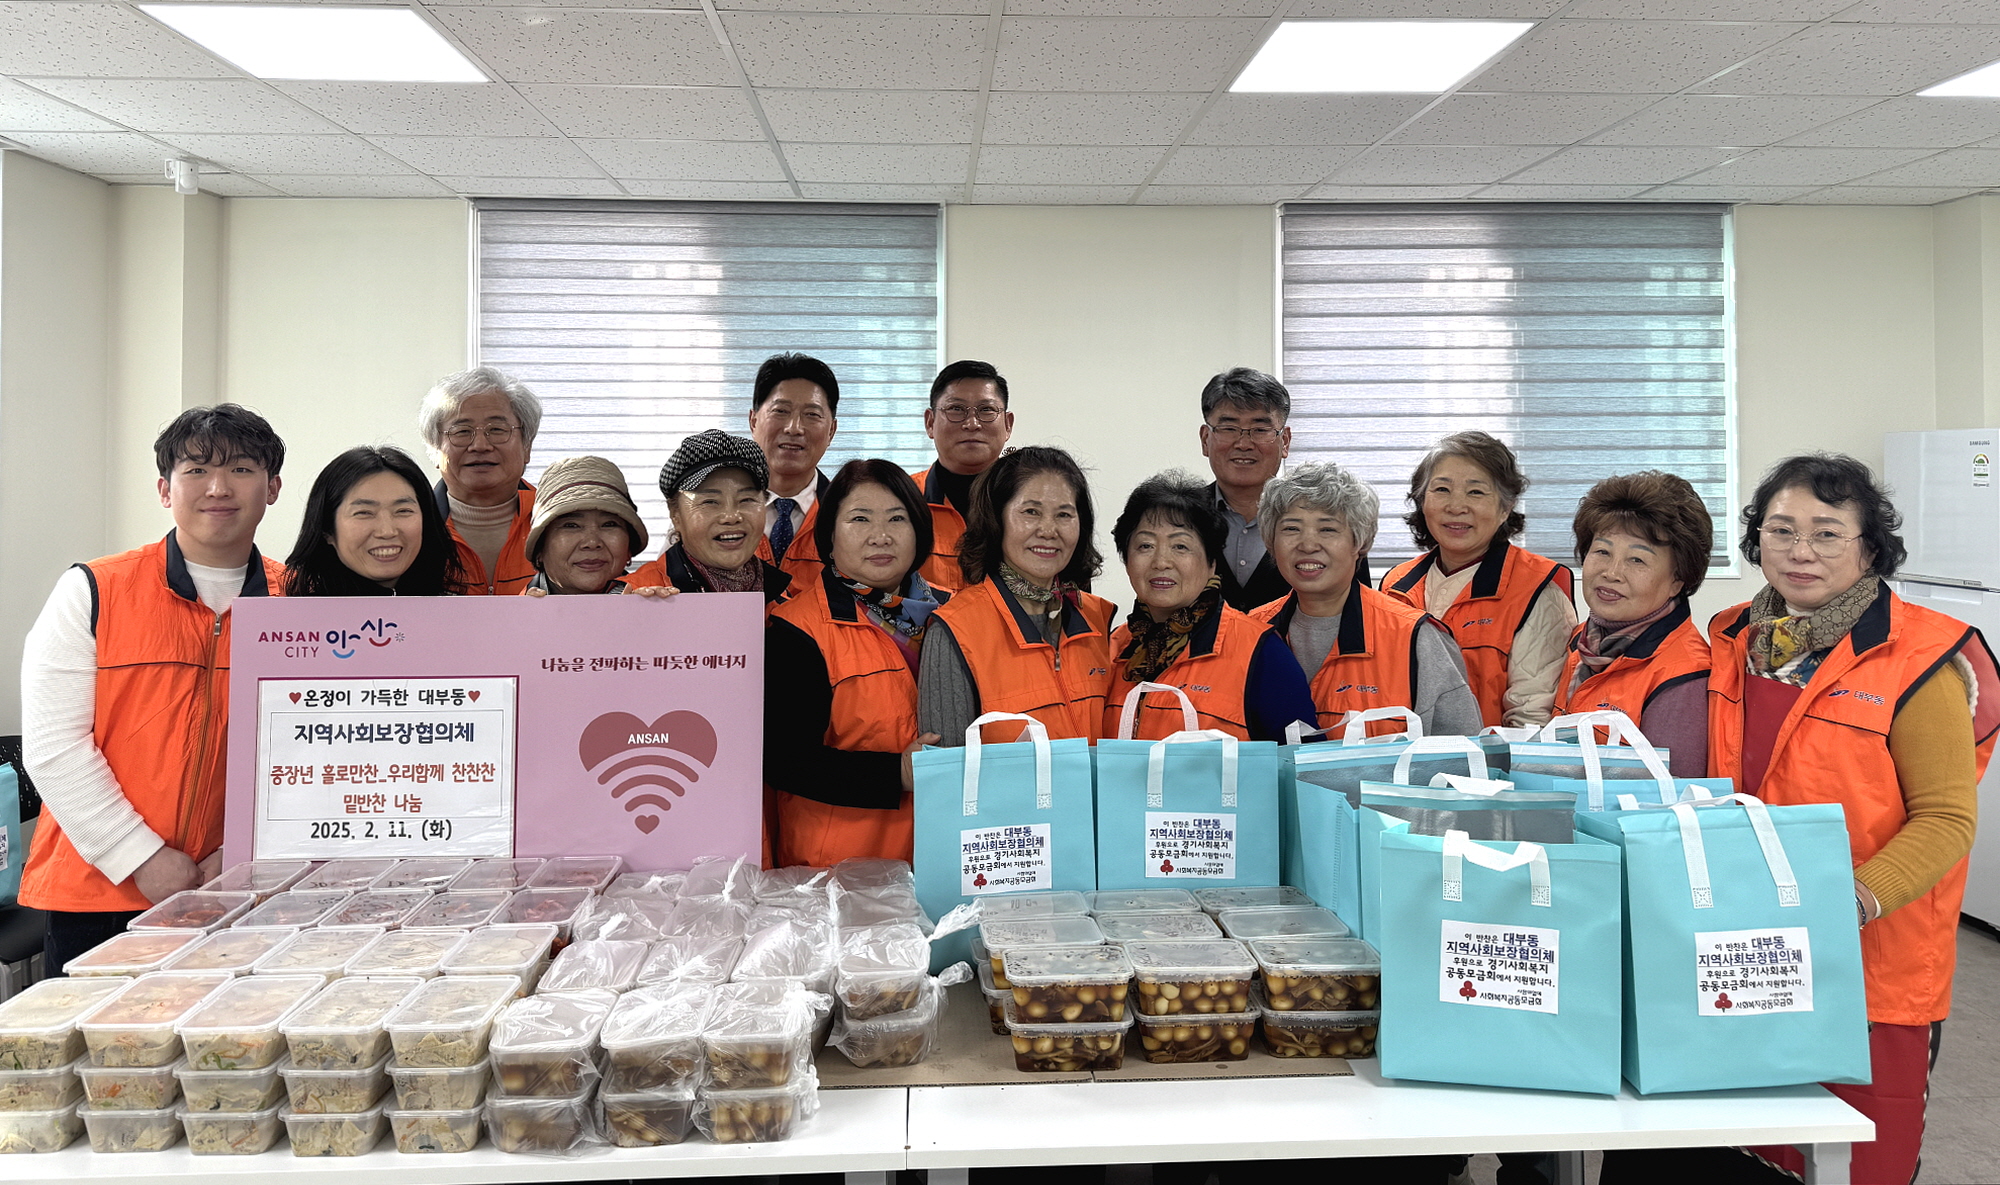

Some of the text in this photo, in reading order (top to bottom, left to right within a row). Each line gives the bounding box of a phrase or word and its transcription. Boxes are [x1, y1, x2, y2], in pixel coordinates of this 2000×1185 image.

[258, 631, 320, 642] ANSAN
[284, 646, 319, 658] CITY
[541, 657, 585, 672] 나눔을
[589, 656, 649, 672] 전파하는
[702, 654, 746, 669] 에너지
[303, 688, 466, 707] 온정이 가득한 대부동
[1854, 690, 1884, 705] 대부동
[294, 722, 475, 744] 지역사회보장협의체
[627, 733, 669, 744] ANSAN
[270, 762, 496, 785] 중장년 홀로만찬_우리함께 찬찬찬
[343, 792, 423, 814] 밑반찬 나눔
[310, 819, 452, 841] 2025. 2. 11. (화)
[1193, 819, 1221, 829] 대부동
[1004, 826, 1032, 838] 대부동
[1149, 828, 1233, 841] 지역사회보장협의체
[962, 836, 1044, 854] 지역사회보장협의체
[1182, 840, 1228, 850] 경기사회복지
[994, 849, 1040, 861] 경기사회복지
[1476, 934, 1499, 944] 반찬은
[1503, 933, 1539, 947] 대부동
[1715, 936, 1785, 952] 이 반찬은 대부동
[1446, 941, 1555, 963] 지역사회보장협의체
[1698, 949, 1802, 966] 지역사회보장협의체
[1453, 957, 1548, 974] 후원으로 경기사회복지
[1706, 965, 1798, 979] 후원으로 경기사회복지
[1446, 967, 1511, 982] 공동모금회에서
[1699, 979, 1763, 992] 공동모금회에서
